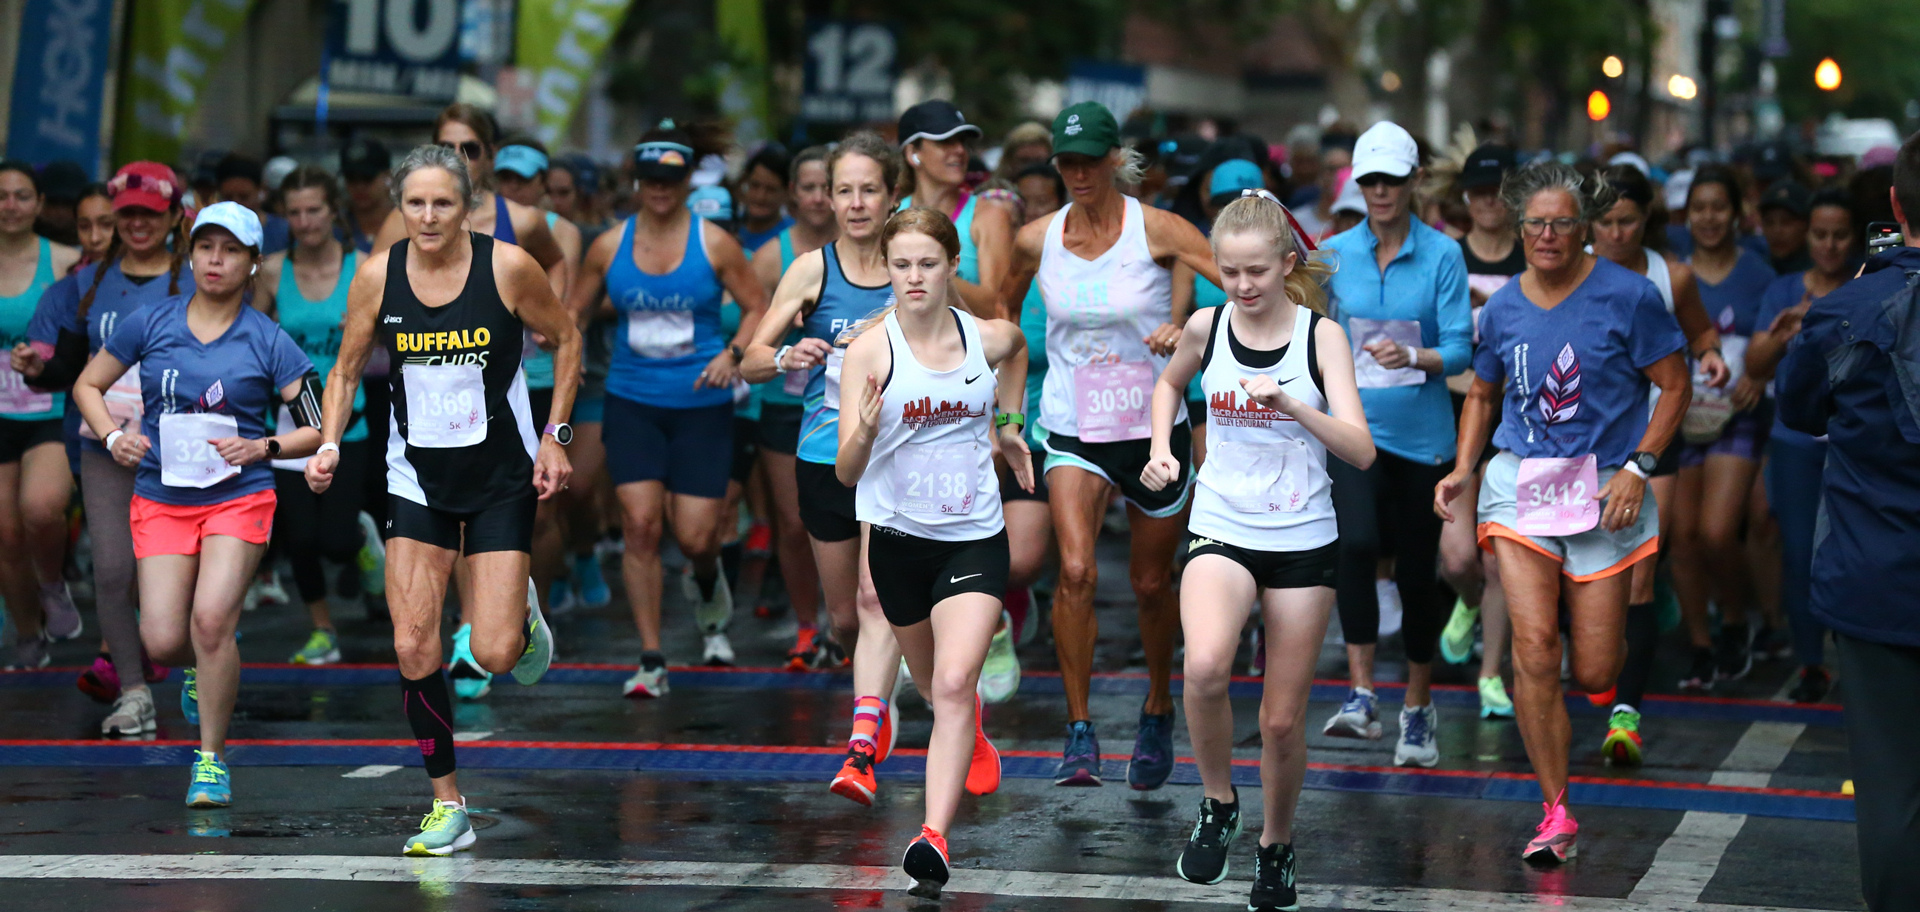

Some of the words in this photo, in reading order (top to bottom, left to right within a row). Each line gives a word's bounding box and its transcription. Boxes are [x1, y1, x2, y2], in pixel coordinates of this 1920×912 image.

[345, 0, 457, 62] 10
[808, 24, 896, 92] 12
[1059, 281, 1109, 309] SAN
[396, 327, 491, 352] BUFFALO
[417, 390, 473, 416] 1369
[1087, 385, 1144, 414] 3030
[902, 409, 970, 424] SACRAMENTO
[1210, 407, 1279, 420] SACRAMENTO
[1235, 419, 1273, 429] ENDURANCE
[906, 471, 968, 498] 2138
[1529, 480, 1587, 507] 3412
